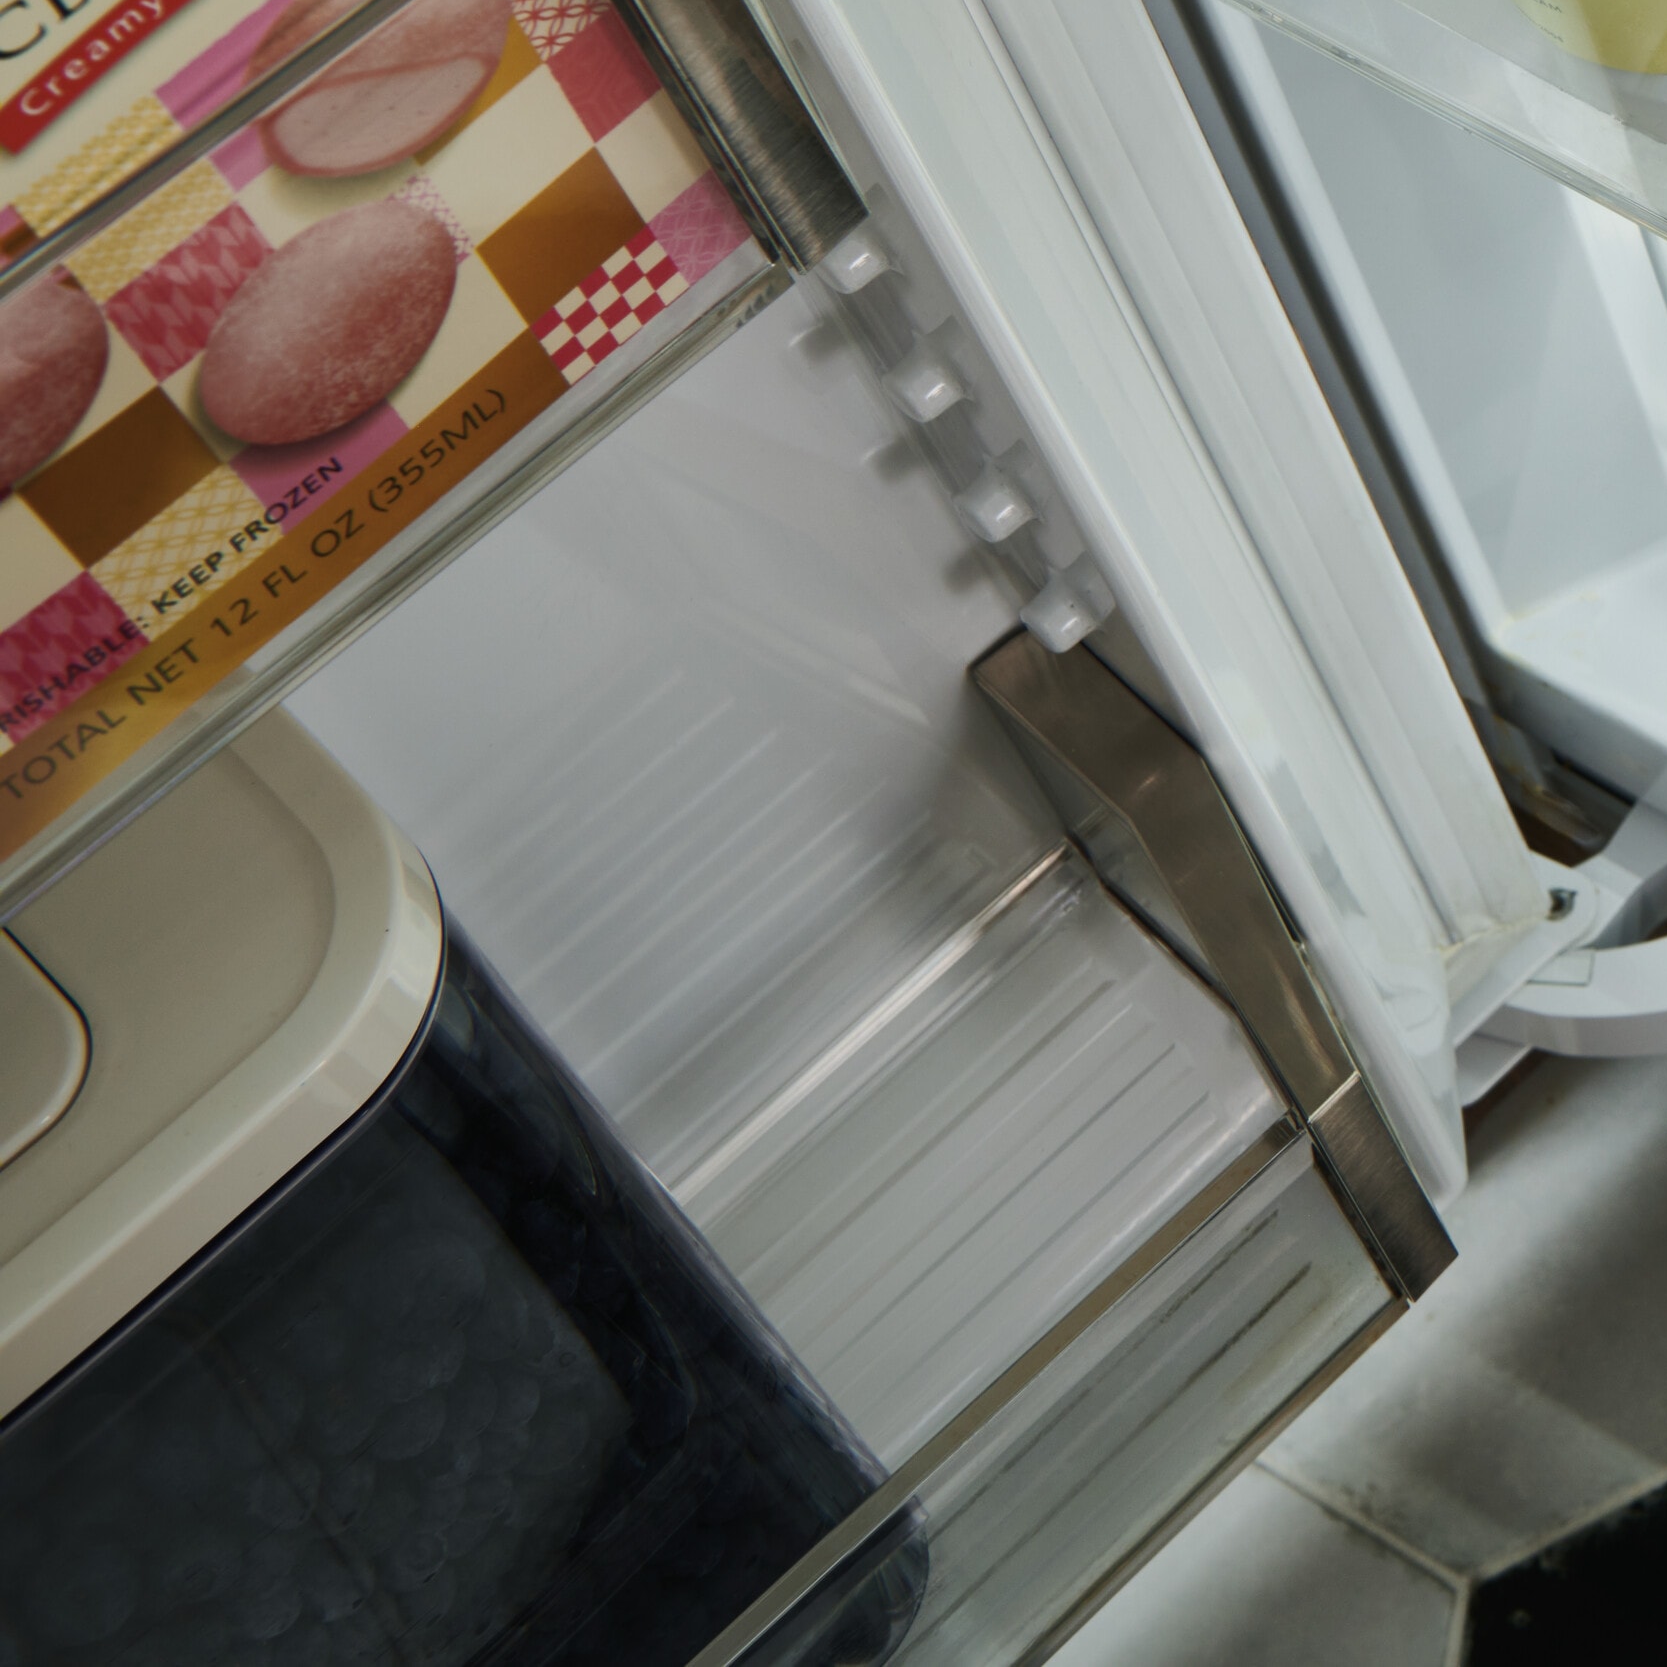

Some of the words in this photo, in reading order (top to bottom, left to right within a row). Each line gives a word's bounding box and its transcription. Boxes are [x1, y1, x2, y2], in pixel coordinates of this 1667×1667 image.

[0, 708, 127, 801] TOTAL
[126, 638, 200, 706] NET
[209, 598, 260, 638] 12
[262, 564, 309, 598] FL
[310, 508, 366, 559] OZ
[367, 388, 507, 513] (355ML)
[150, 551, 226, 615] KEEP
[229, 456, 344, 553] FROZEN
